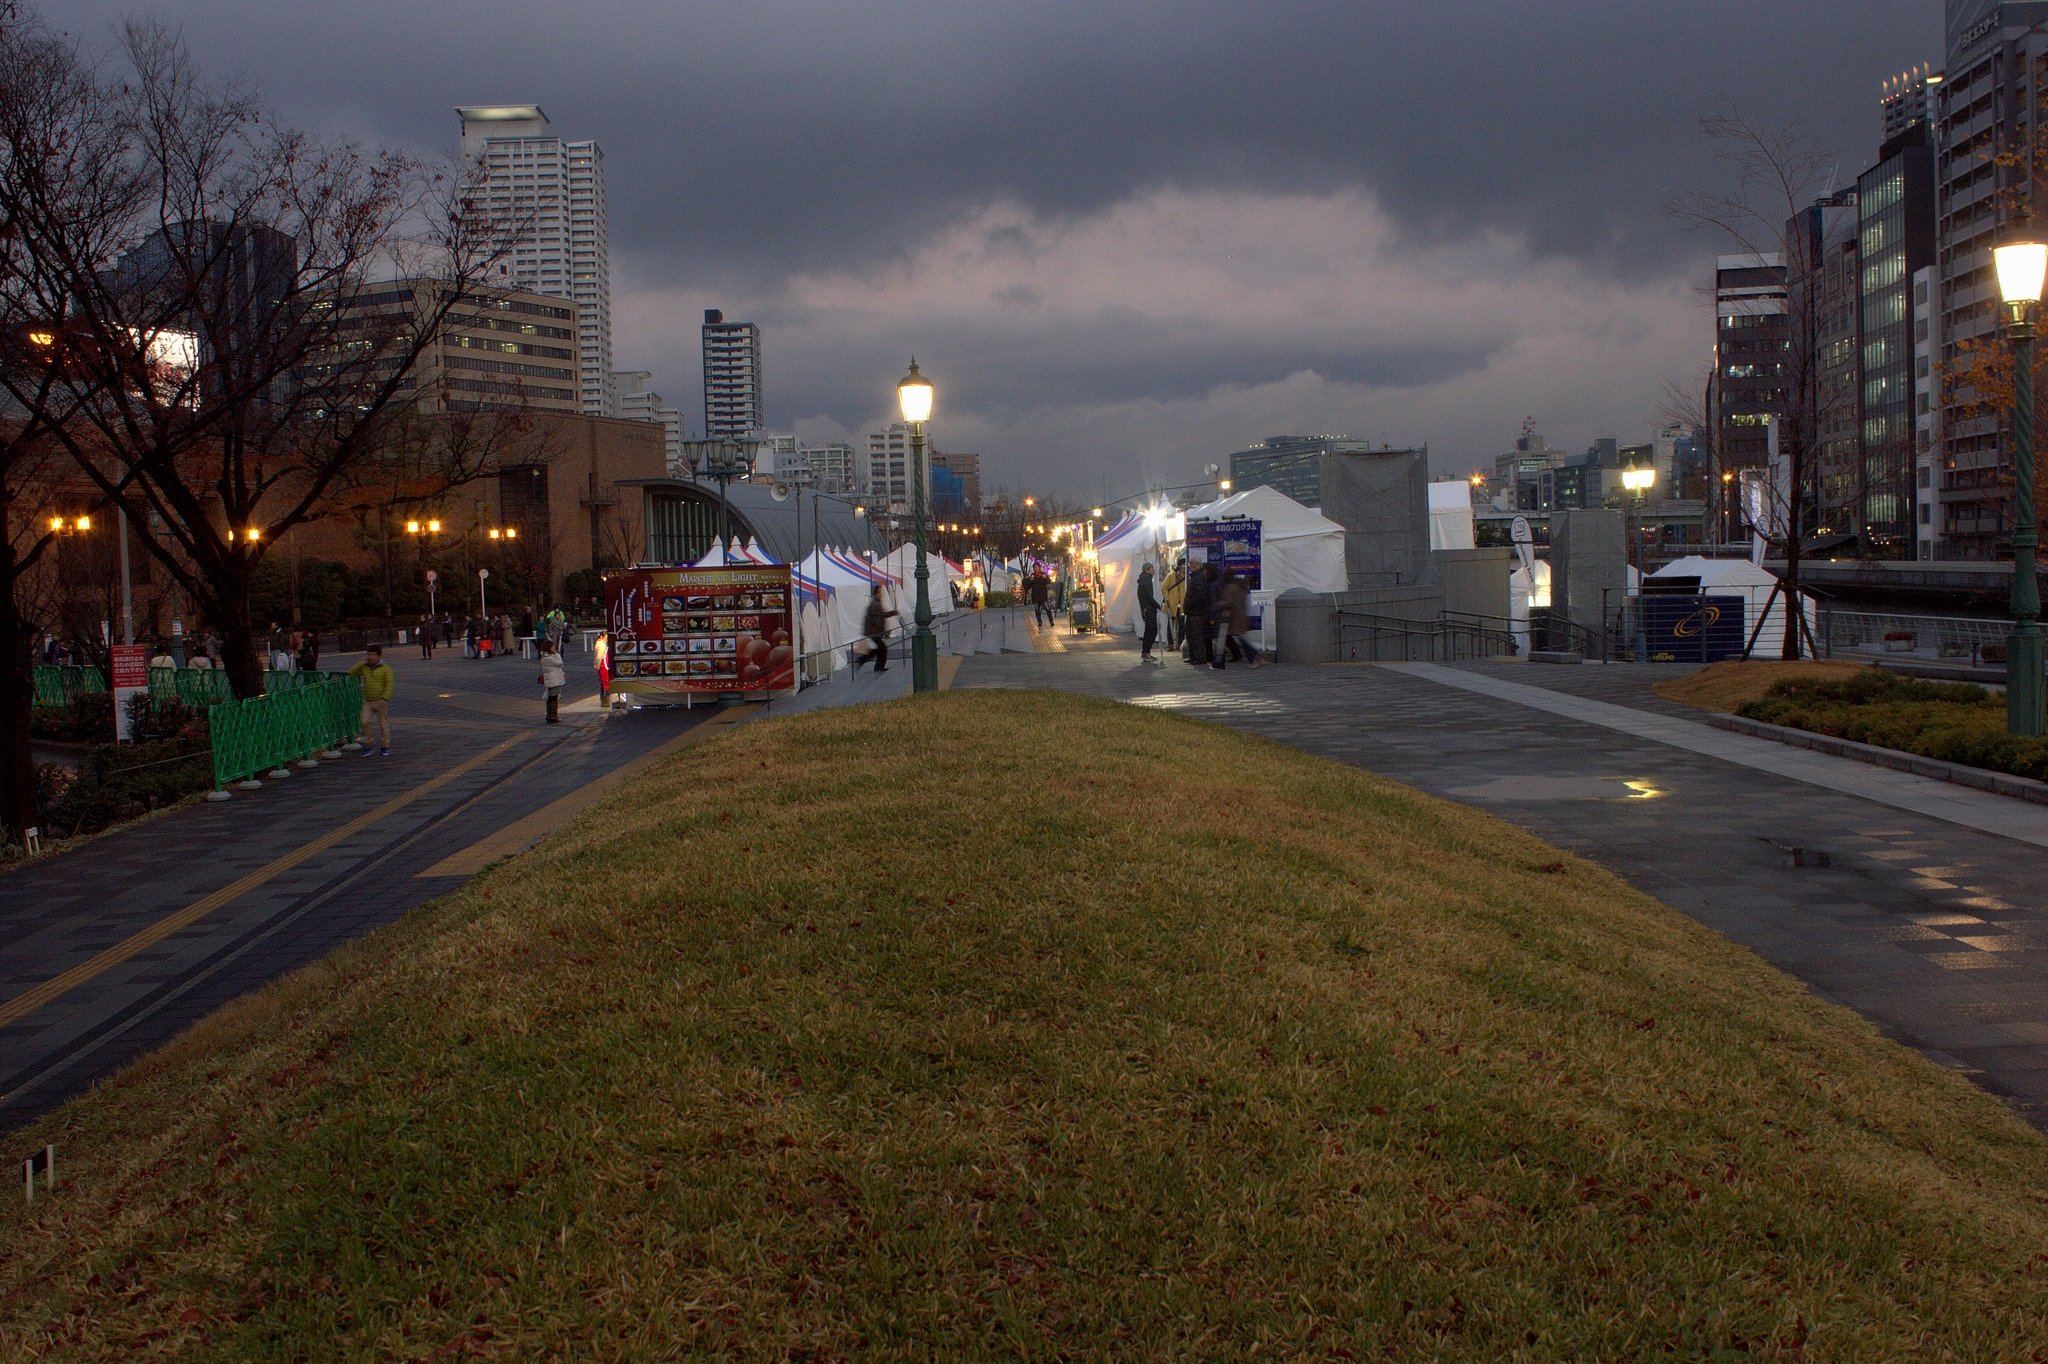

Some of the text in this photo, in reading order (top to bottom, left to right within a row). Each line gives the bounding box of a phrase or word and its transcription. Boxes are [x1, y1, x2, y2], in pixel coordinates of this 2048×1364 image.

[1215, 524, 1257, 532] 本日のプログラム
